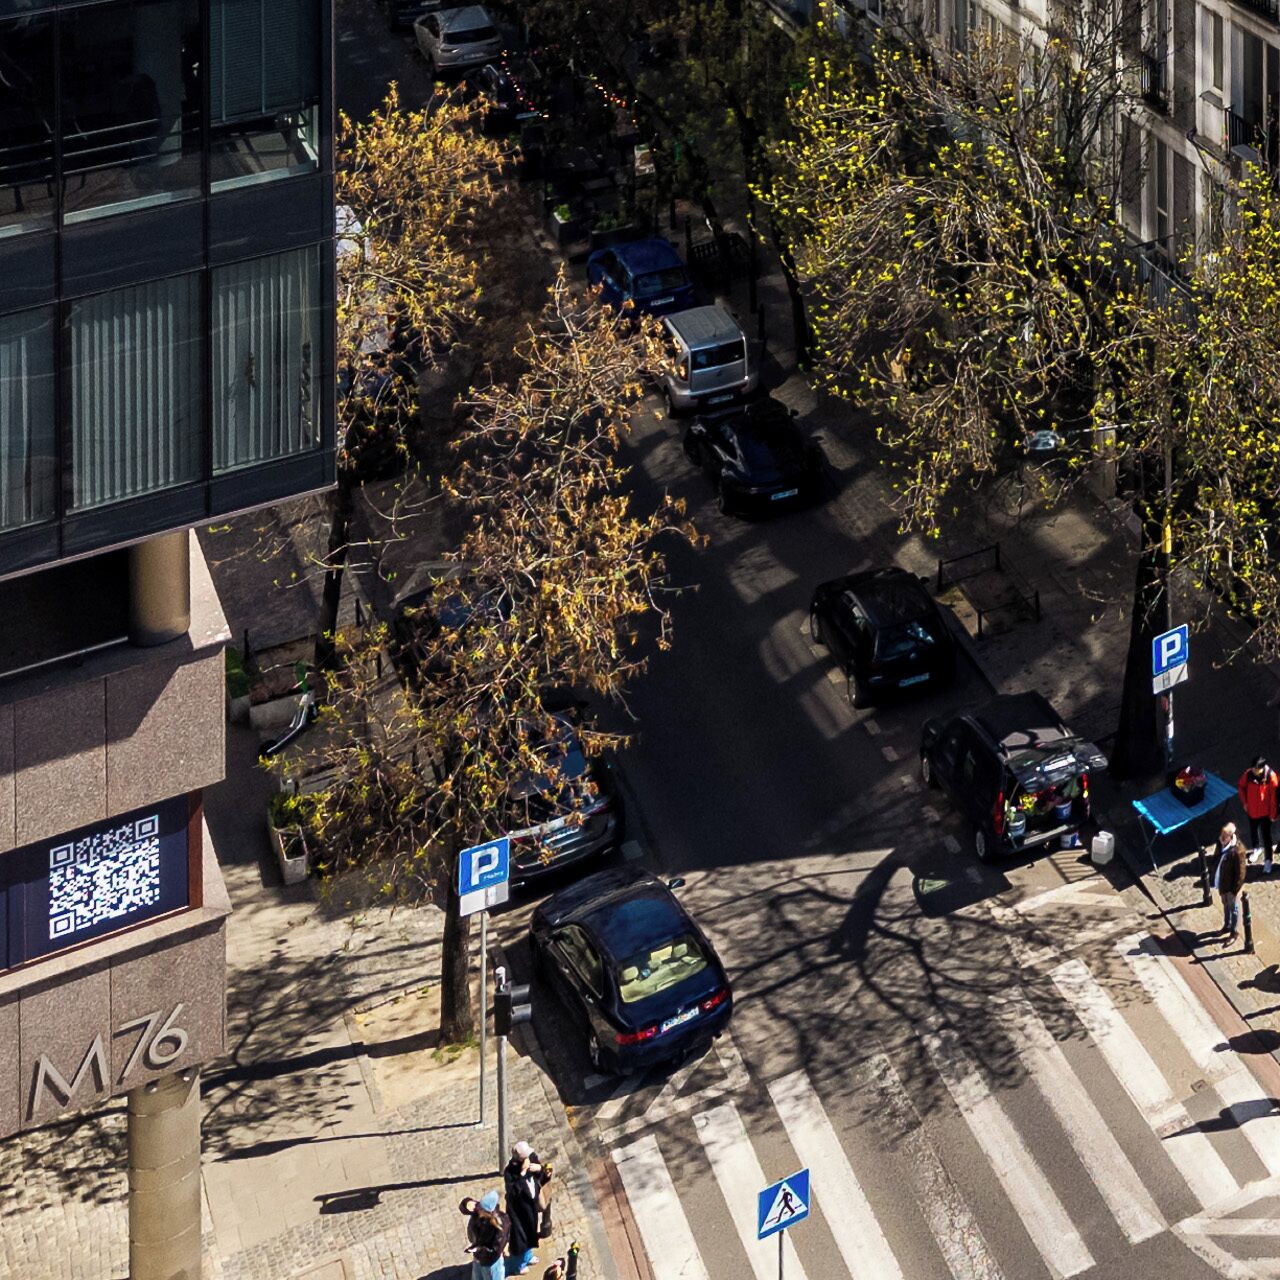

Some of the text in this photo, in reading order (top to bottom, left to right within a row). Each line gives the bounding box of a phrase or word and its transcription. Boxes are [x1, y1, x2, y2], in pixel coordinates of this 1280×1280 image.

[1161, 632, 1181, 667] P
[471, 846, 499, 886] P
[33, 1002, 188, 1111] M76
